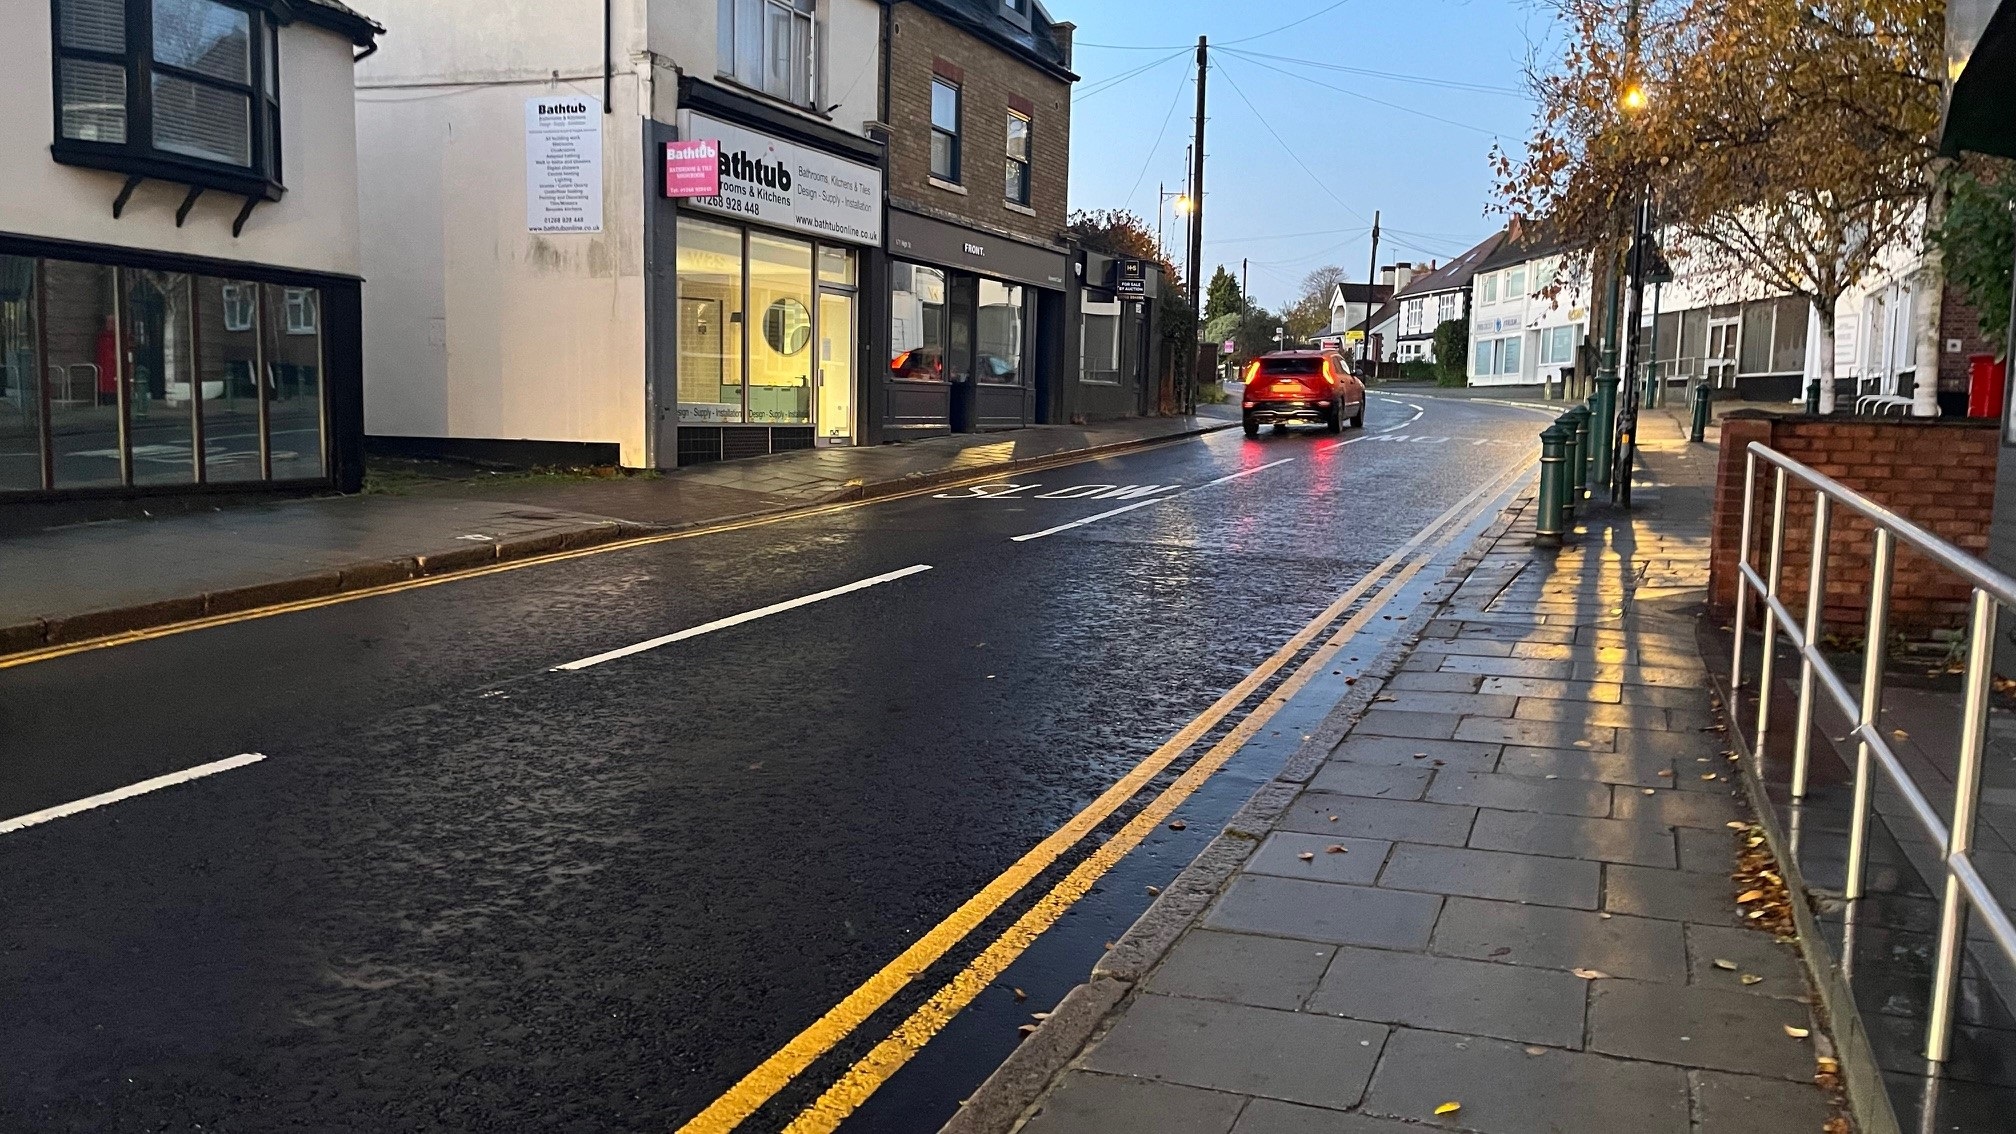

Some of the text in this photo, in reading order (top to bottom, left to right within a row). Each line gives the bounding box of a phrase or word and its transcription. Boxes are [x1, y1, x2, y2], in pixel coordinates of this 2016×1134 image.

[538, 102, 587, 114] Bathtub
[667, 145, 716, 160] Bathtub
[720, 150, 792, 192] athtub
[720, 181, 791, 207] rooms & Kitchens
[830, 175, 852, 191] Kitchens
[859, 182, 871, 196] Tiles
[726, 197, 742, 212] 928
[745, 201, 760, 216] 448
[797, 183, 817, 201] Design
[822, 190, 841, 208] Supply
[845, 196, 872, 213] Installation
[795, 215, 878, 241] www.bathtubonline.co.uk
[693, 407, 711, 419] Supply
[749, 409, 765, 419] Design
[769, 409, 784, 419] Supply
[932, 484, 1182, 499] SLOW
